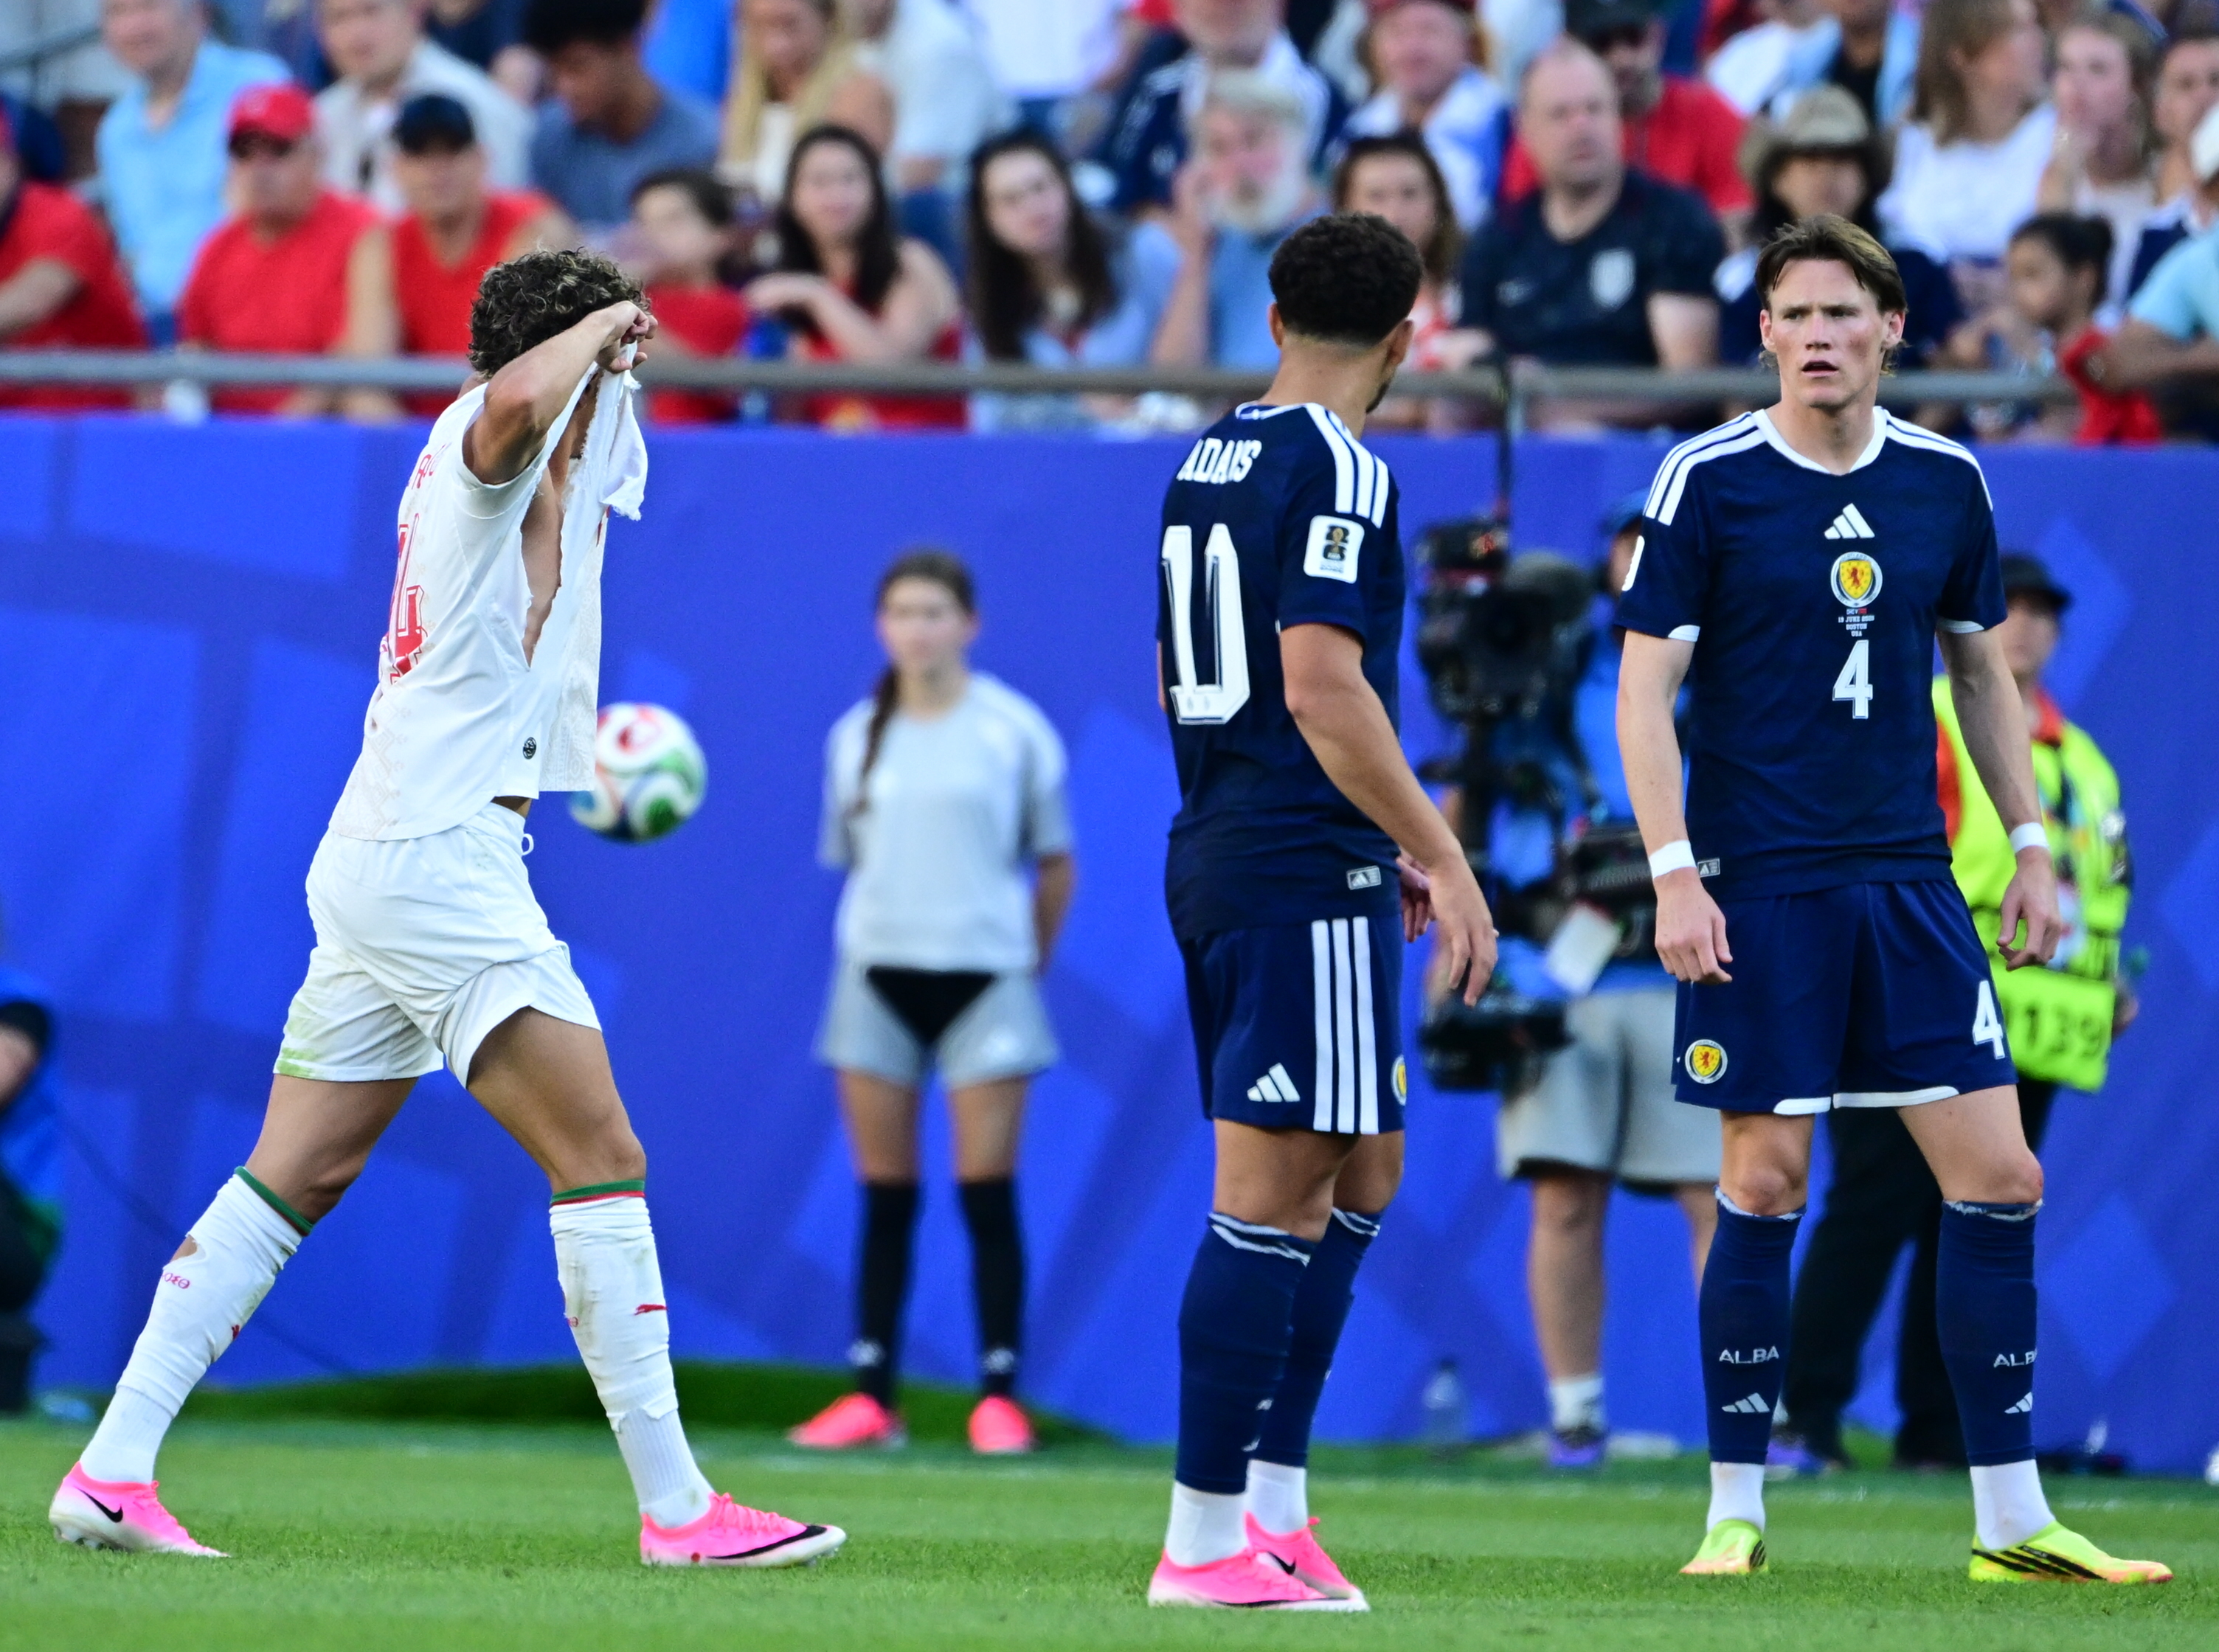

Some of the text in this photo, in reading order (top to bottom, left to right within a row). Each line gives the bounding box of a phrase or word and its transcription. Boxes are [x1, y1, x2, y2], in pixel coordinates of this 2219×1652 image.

[1176, 437, 1262, 485] ADAS
[1845, 615, 1860, 623] JUNE
[1832, 639, 1873, 720] 4
[1973, 980, 2006, 1059] 4
[1719, 1344, 1779, 1364] ALBA
[1993, 1347, 2038, 1368] ALB
